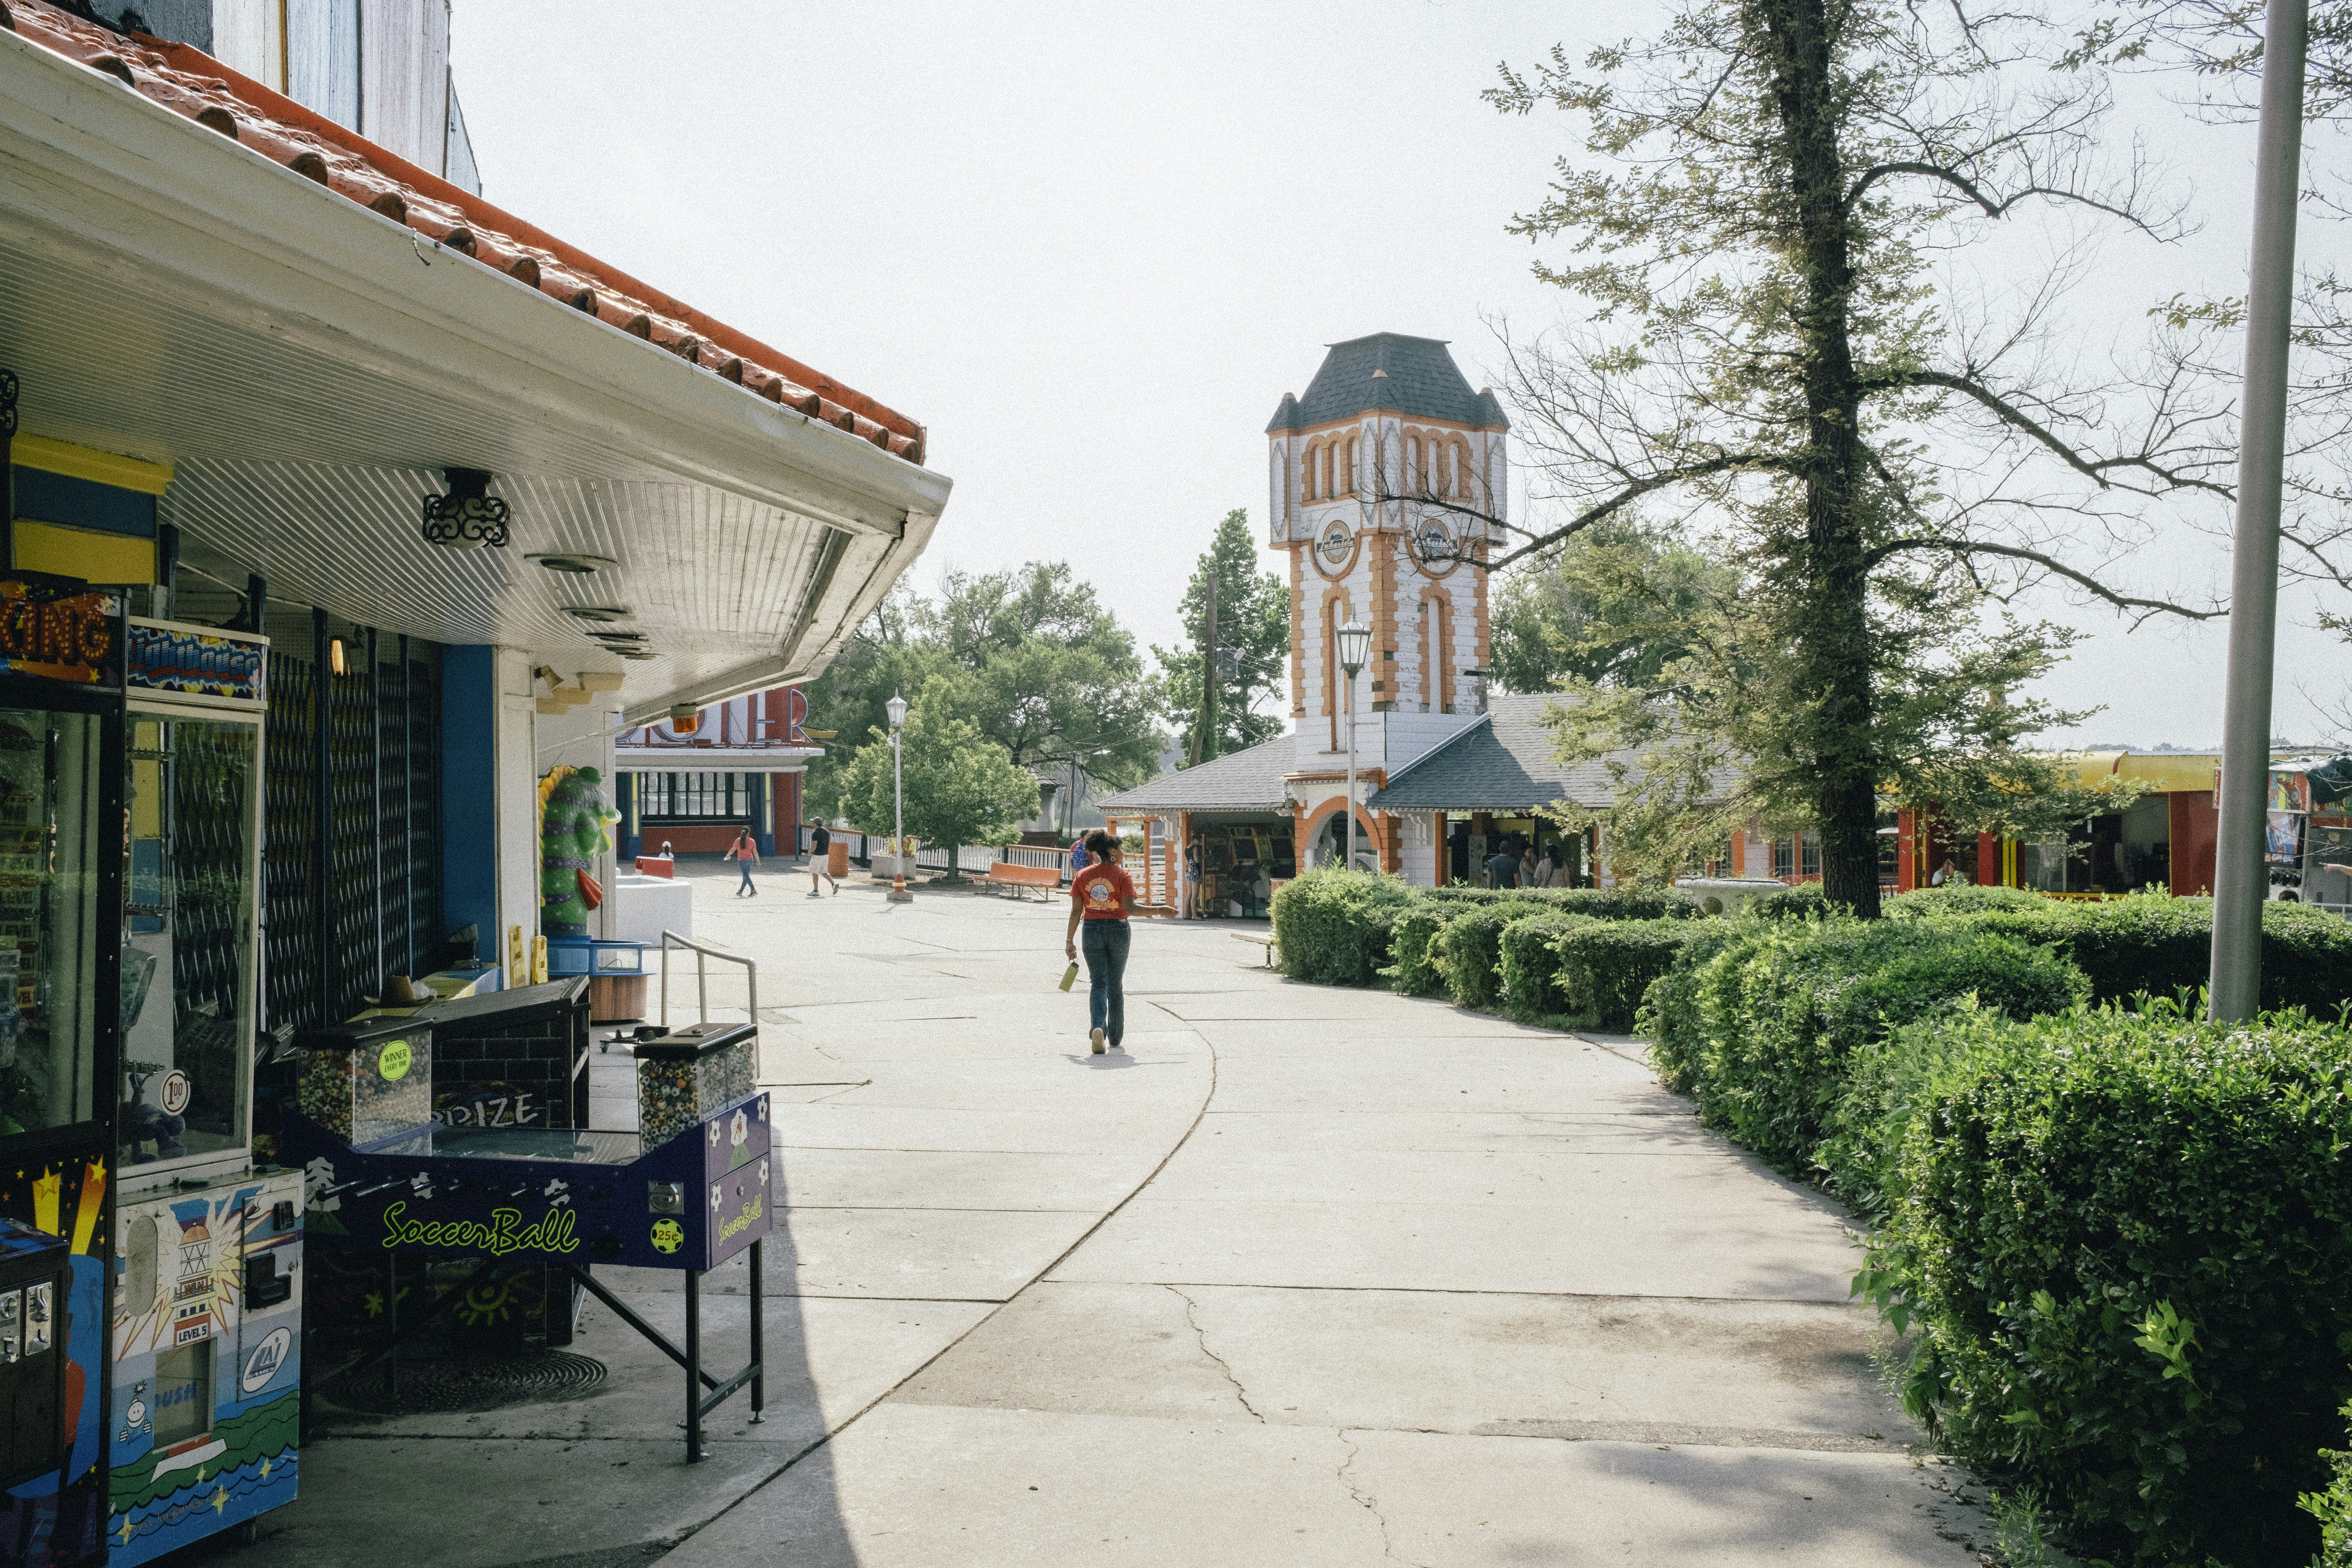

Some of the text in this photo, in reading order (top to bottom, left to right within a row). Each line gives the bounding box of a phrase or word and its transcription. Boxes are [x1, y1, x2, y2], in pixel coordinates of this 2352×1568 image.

[1318, 537, 1355, 552] Lakeside
[128, 637, 258, 677] Lighthouse
[384, 1049, 407, 1063] WINNER
[384, 1063, 397, 1072] EVERY
[718, 1193, 763, 1246] SoccerBall
[383, 1200, 580, 1256] SoccerBall
[658, 1230, 679, 1242] 25¢
[178, 1326, 207, 1343] LEVEL 5
[246, 1366, 276, 1379] GAMES
